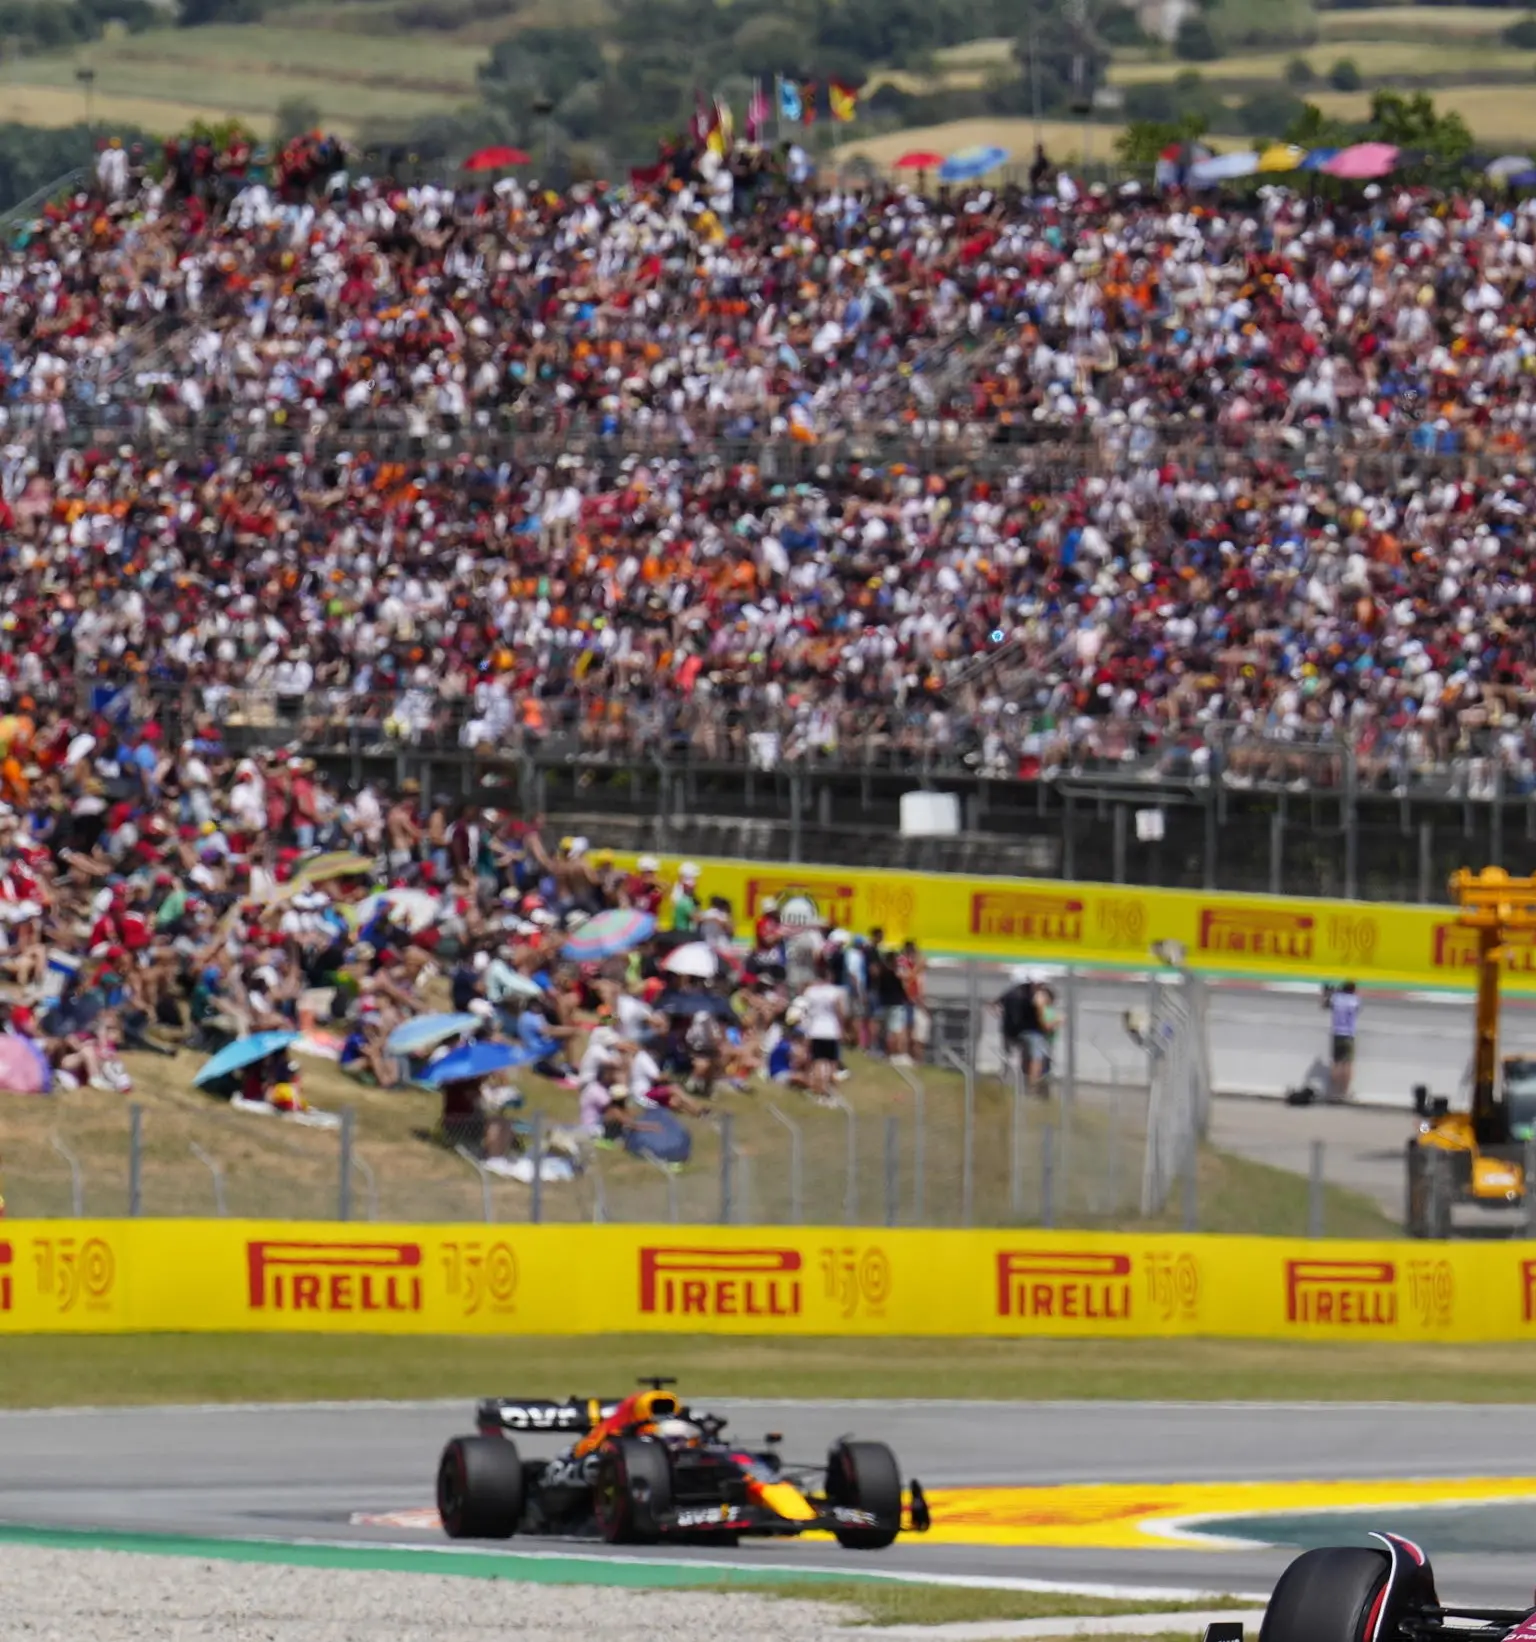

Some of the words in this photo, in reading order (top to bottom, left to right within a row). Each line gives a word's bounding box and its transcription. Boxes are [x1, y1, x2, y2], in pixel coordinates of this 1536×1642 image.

[970, 892, 1084, 941] PIRELLI
[1198, 908, 1315, 959] PIRELLI
[247, 1241, 422, 1311] PIRELLI
[639, 1247, 802, 1315] PIRELLI
[996, 1251, 1131, 1318] PIRELLI
[1286, 1259, 1396, 1325] PIRELLI
